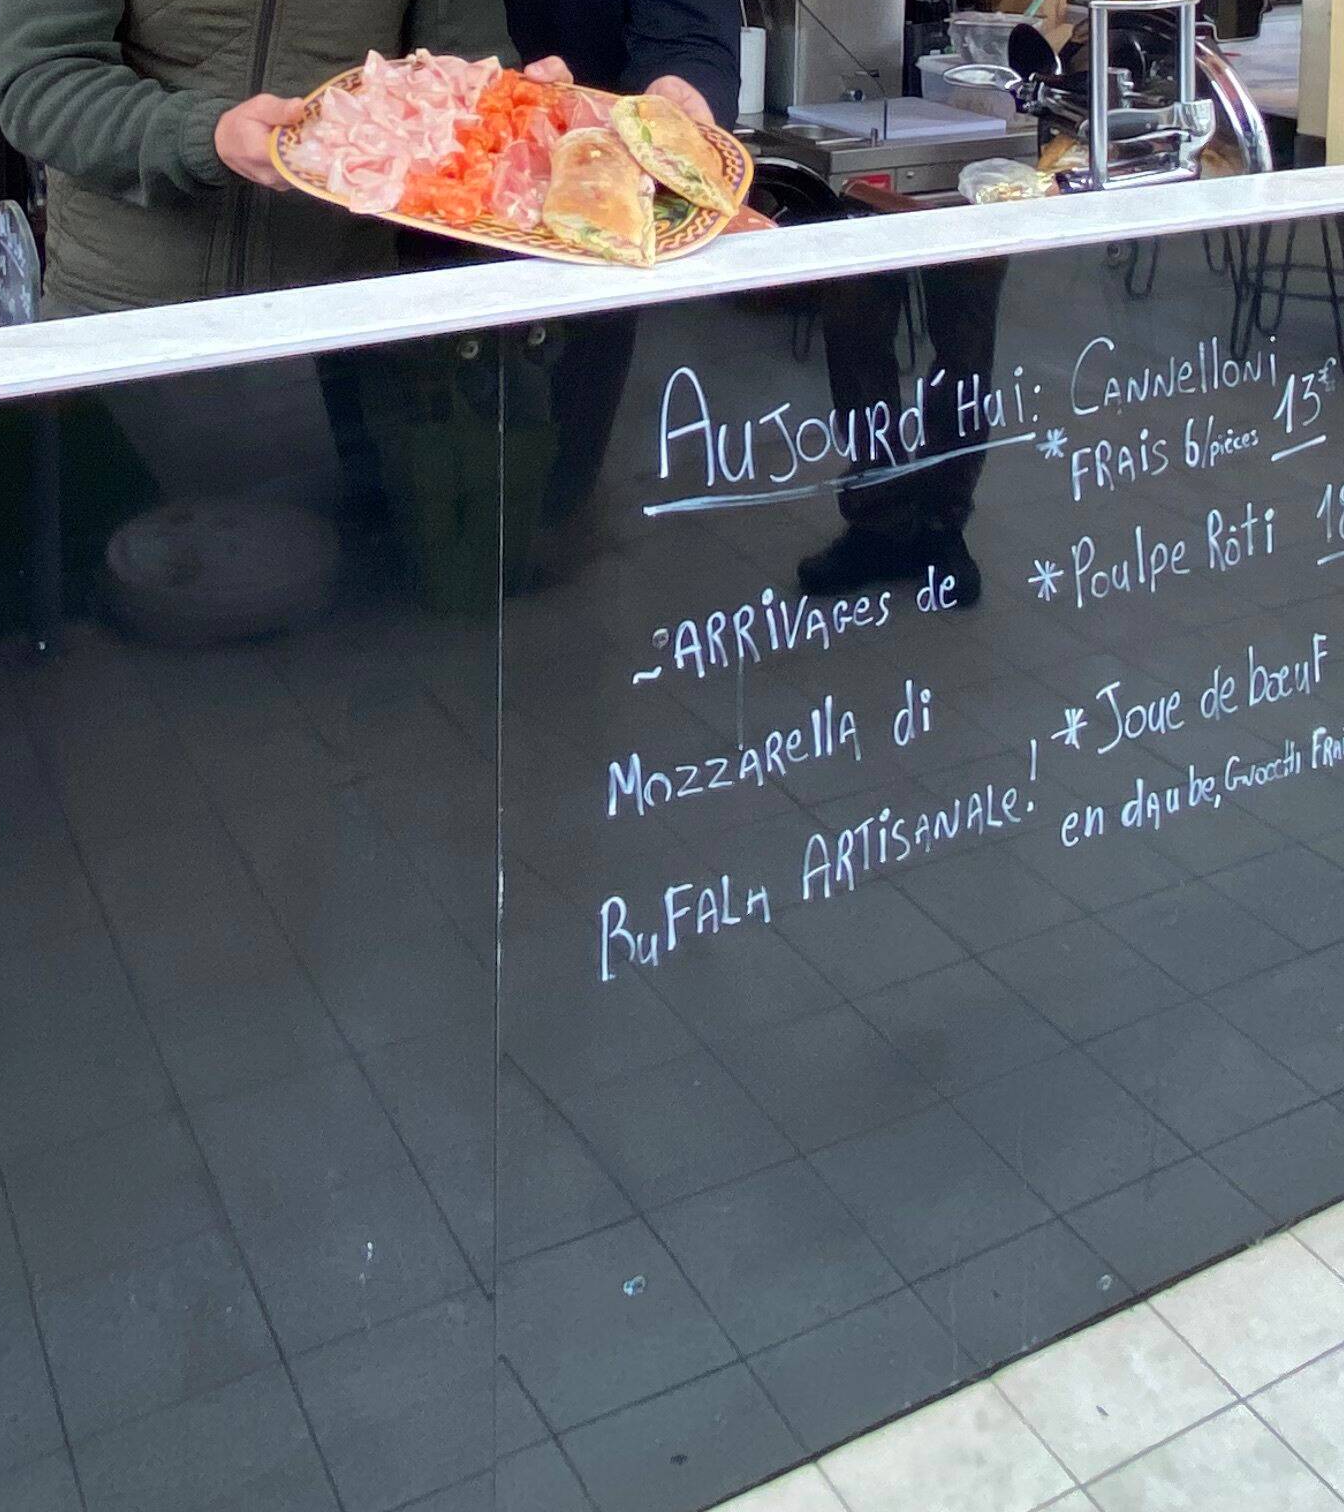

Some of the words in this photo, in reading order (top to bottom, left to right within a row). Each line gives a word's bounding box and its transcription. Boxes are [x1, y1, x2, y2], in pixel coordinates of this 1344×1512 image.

[915, 564, 957, 613] de
[1071, 525, 1191, 608] Poulpe
[893, 679, 932, 747] di
[1095, 681, 1186, 755] Joue
[1199, 663, 1239, 721] de
[1060, 805, 1104, 848] en
